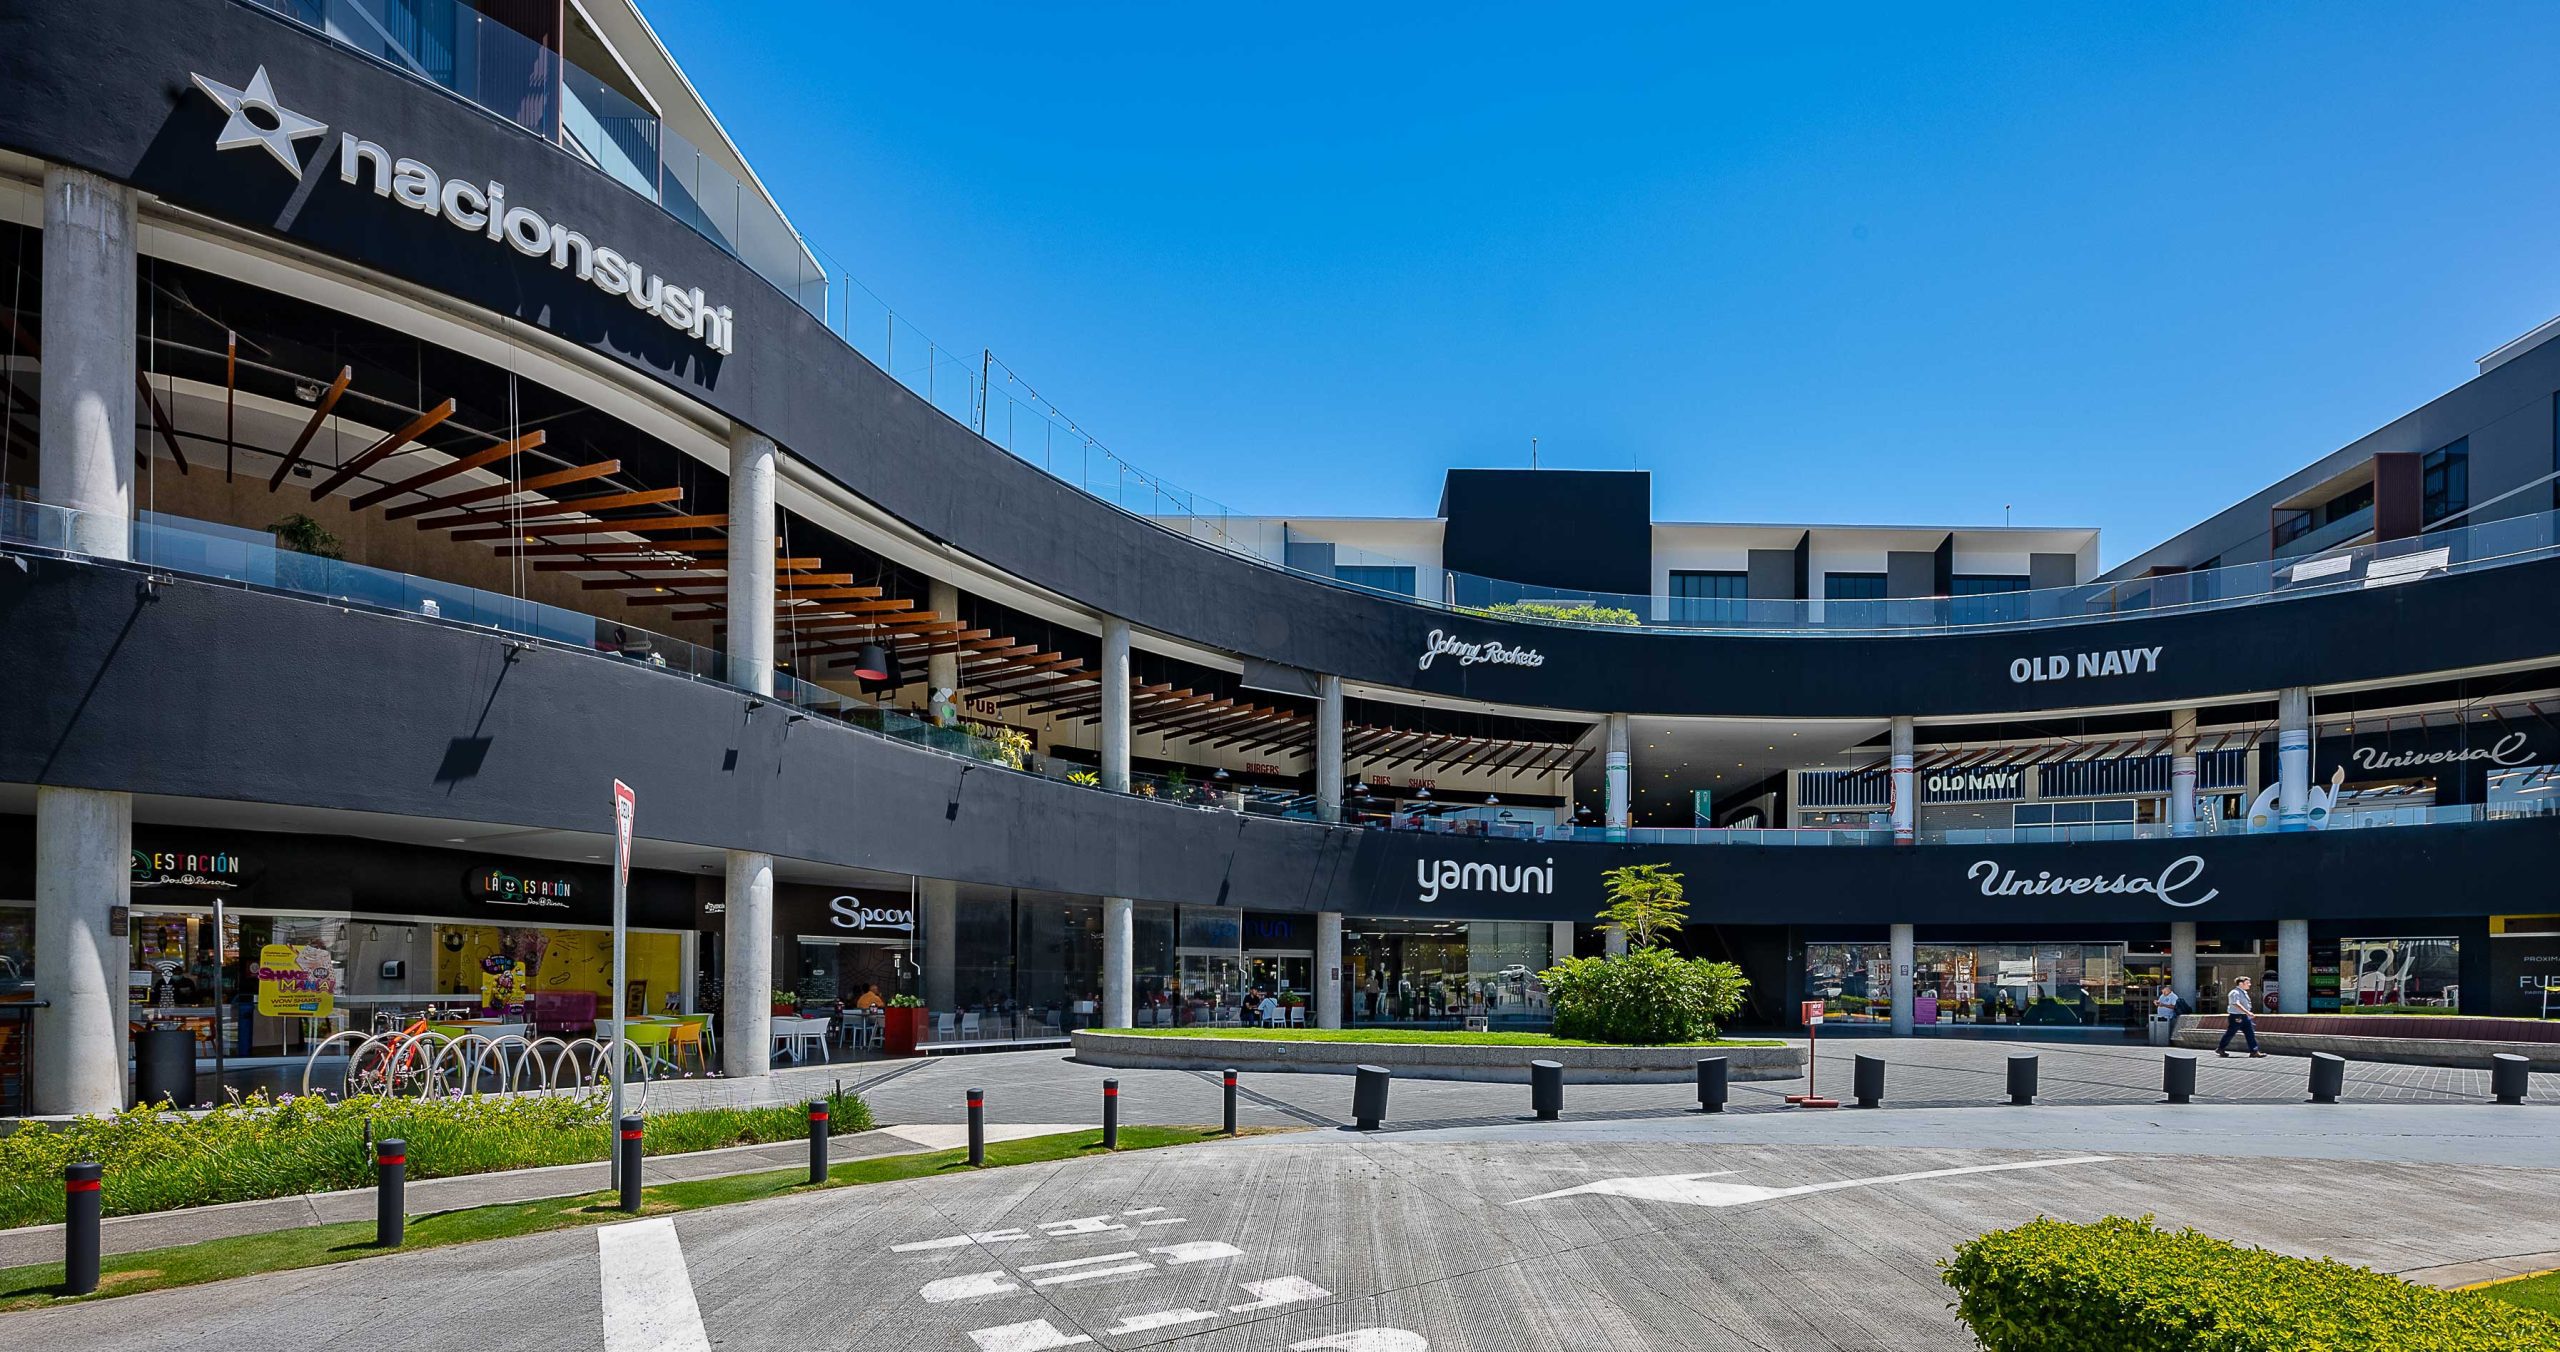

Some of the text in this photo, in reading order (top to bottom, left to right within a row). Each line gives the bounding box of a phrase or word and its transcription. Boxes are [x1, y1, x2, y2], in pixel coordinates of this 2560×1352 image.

[341, 131, 733, 357] nacionsushi
[1418, 628, 1545, 671] Johnny Rockets
[2009, 646, 2163, 684] OLD NAVY
[965, 698, 995, 715] PUB
[2353, 732, 2537, 771] Universal
[1246, 762, 1280, 775] BURGERS
[1372, 774, 1391, 786] FRIES
[1408, 778, 1436, 789] SHAKES
[1927, 771, 2020, 792] OLD NAVY
[154, 852, 239, 874] ESTACIÓN
[160, 874, 181, 886] Dos
[524, 879, 571, 897] ESTACIÓN
[1417, 857, 1554, 902] yamuni
[1967, 855, 2219, 907] Universal
[829, 895, 915, 931] Spoon
